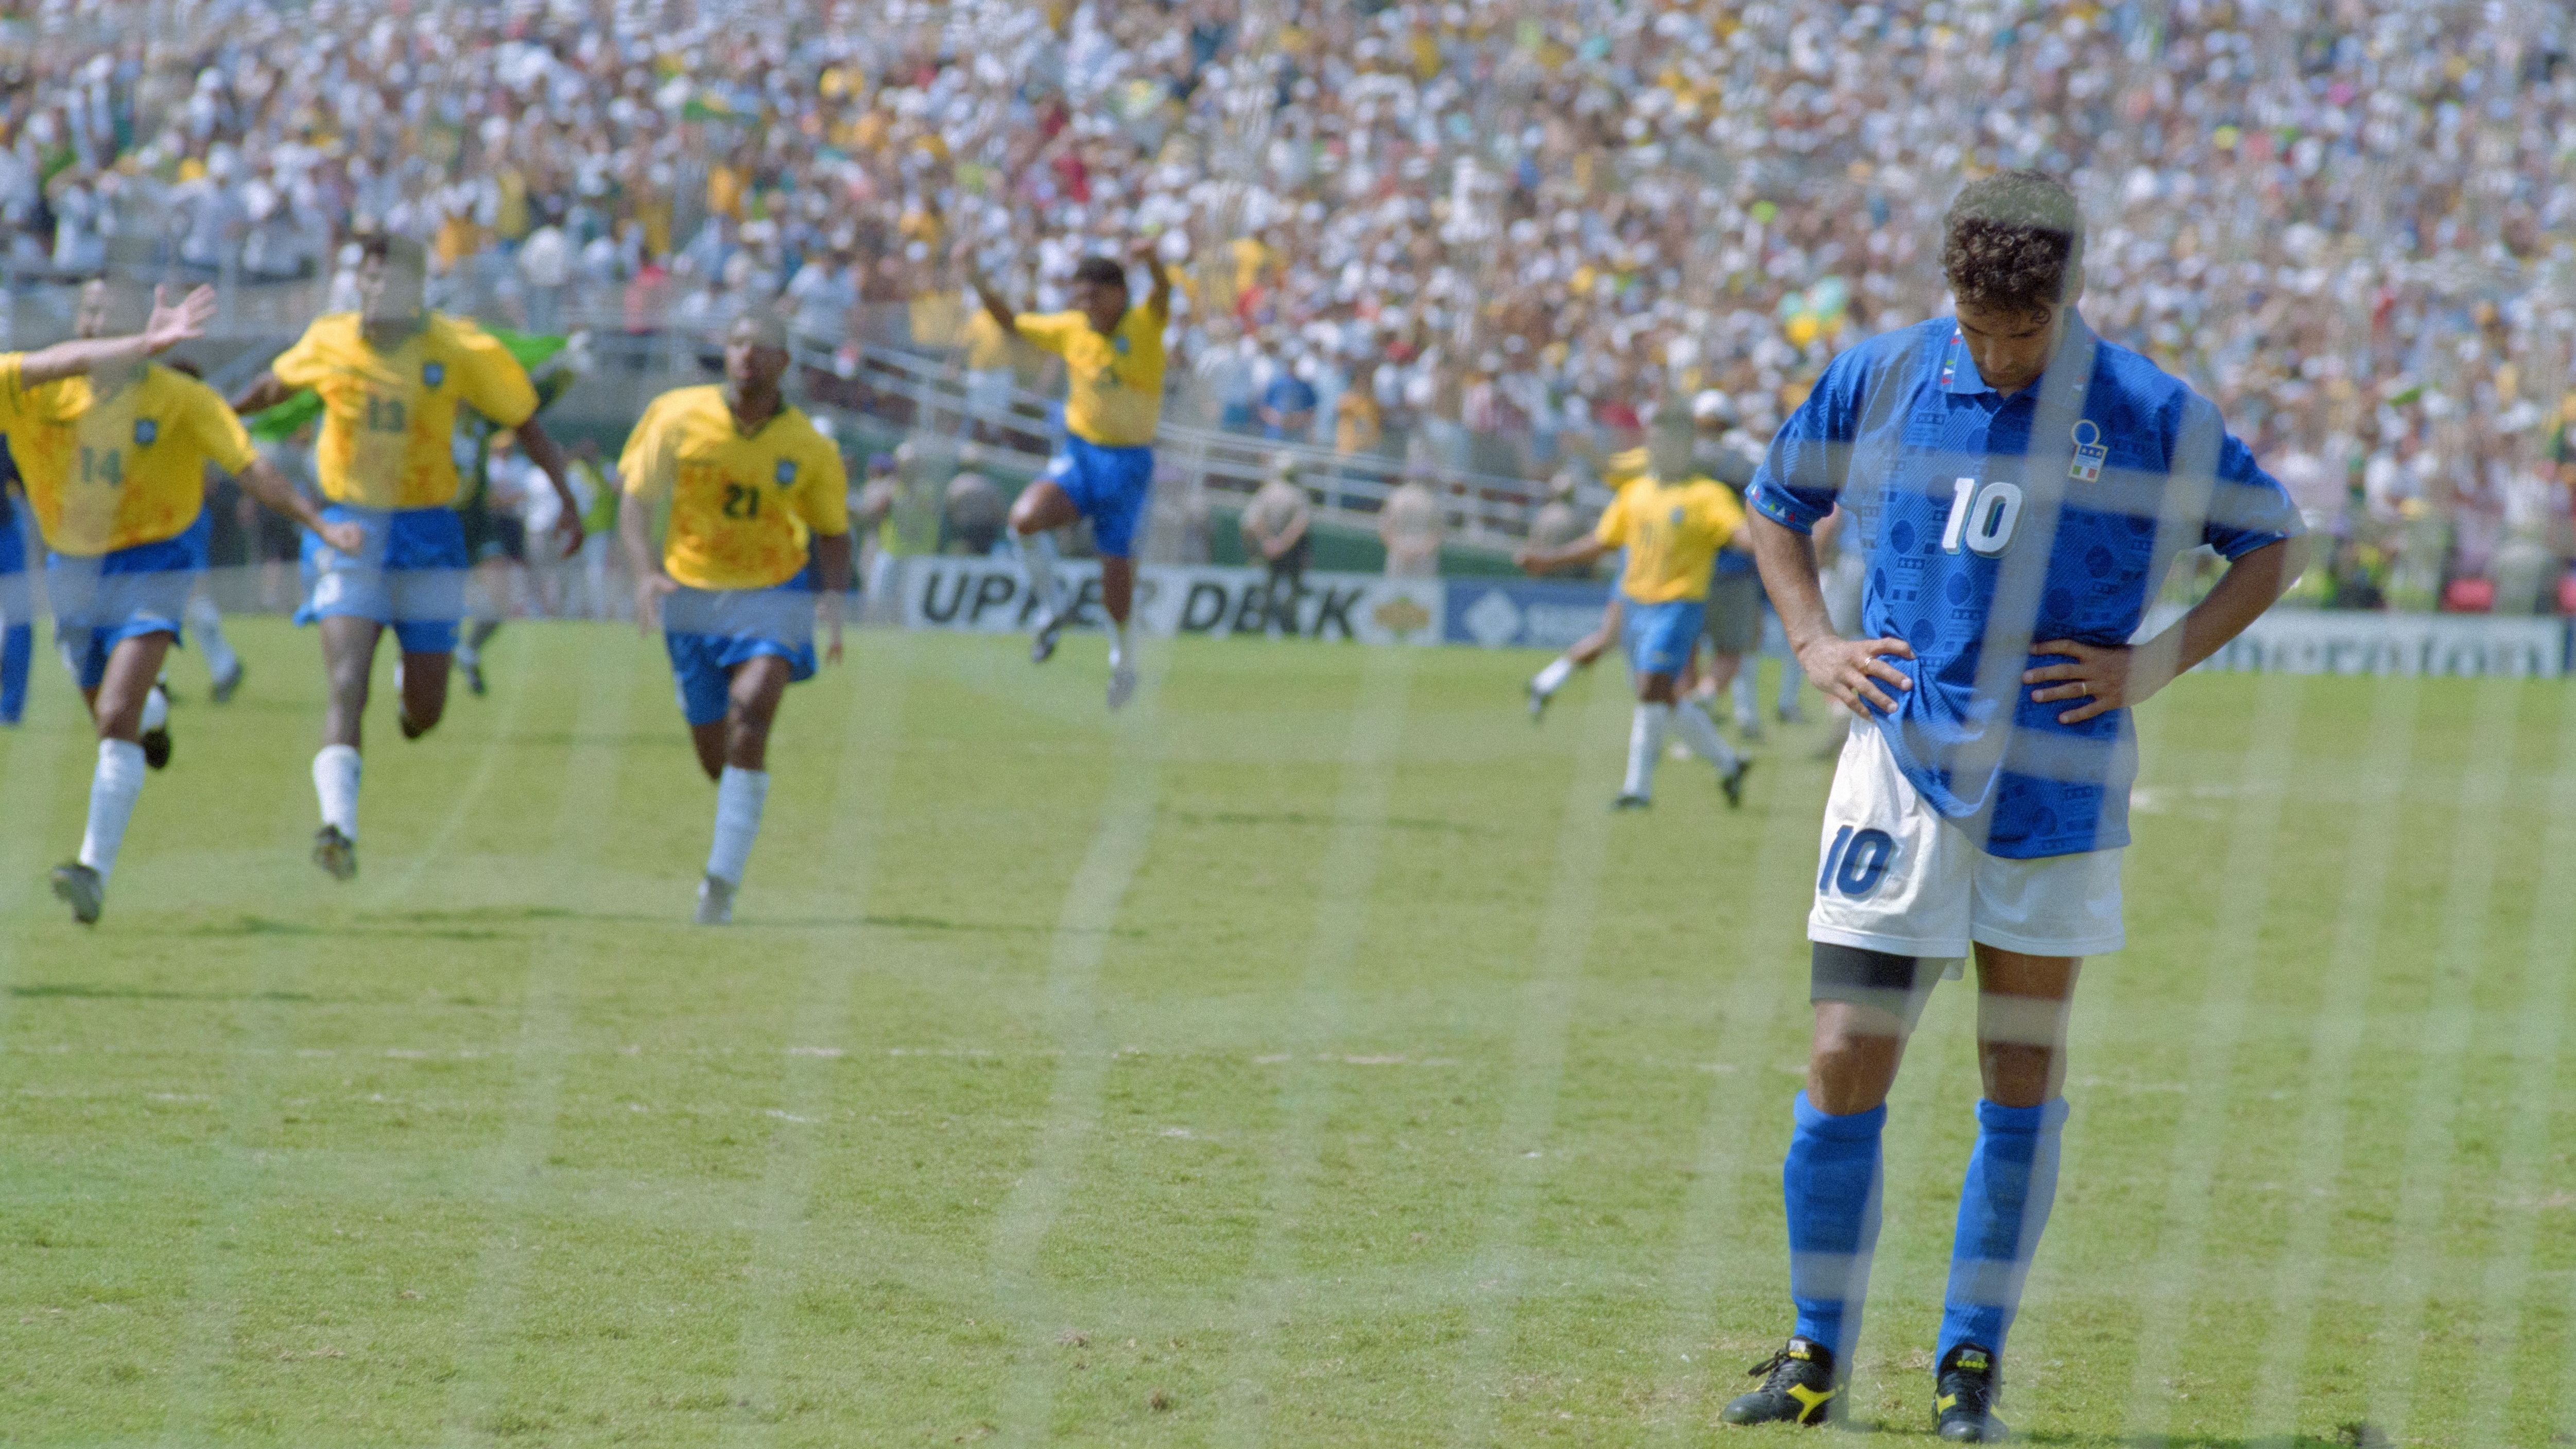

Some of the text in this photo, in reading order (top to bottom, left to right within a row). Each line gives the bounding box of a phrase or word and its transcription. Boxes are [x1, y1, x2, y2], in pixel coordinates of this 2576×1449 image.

[80, 445, 124, 489] 14
[724, 483, 759, 520] 21
[1942, 478, 2025, 559] 10
[1819, 824, 1897, 902] 10
